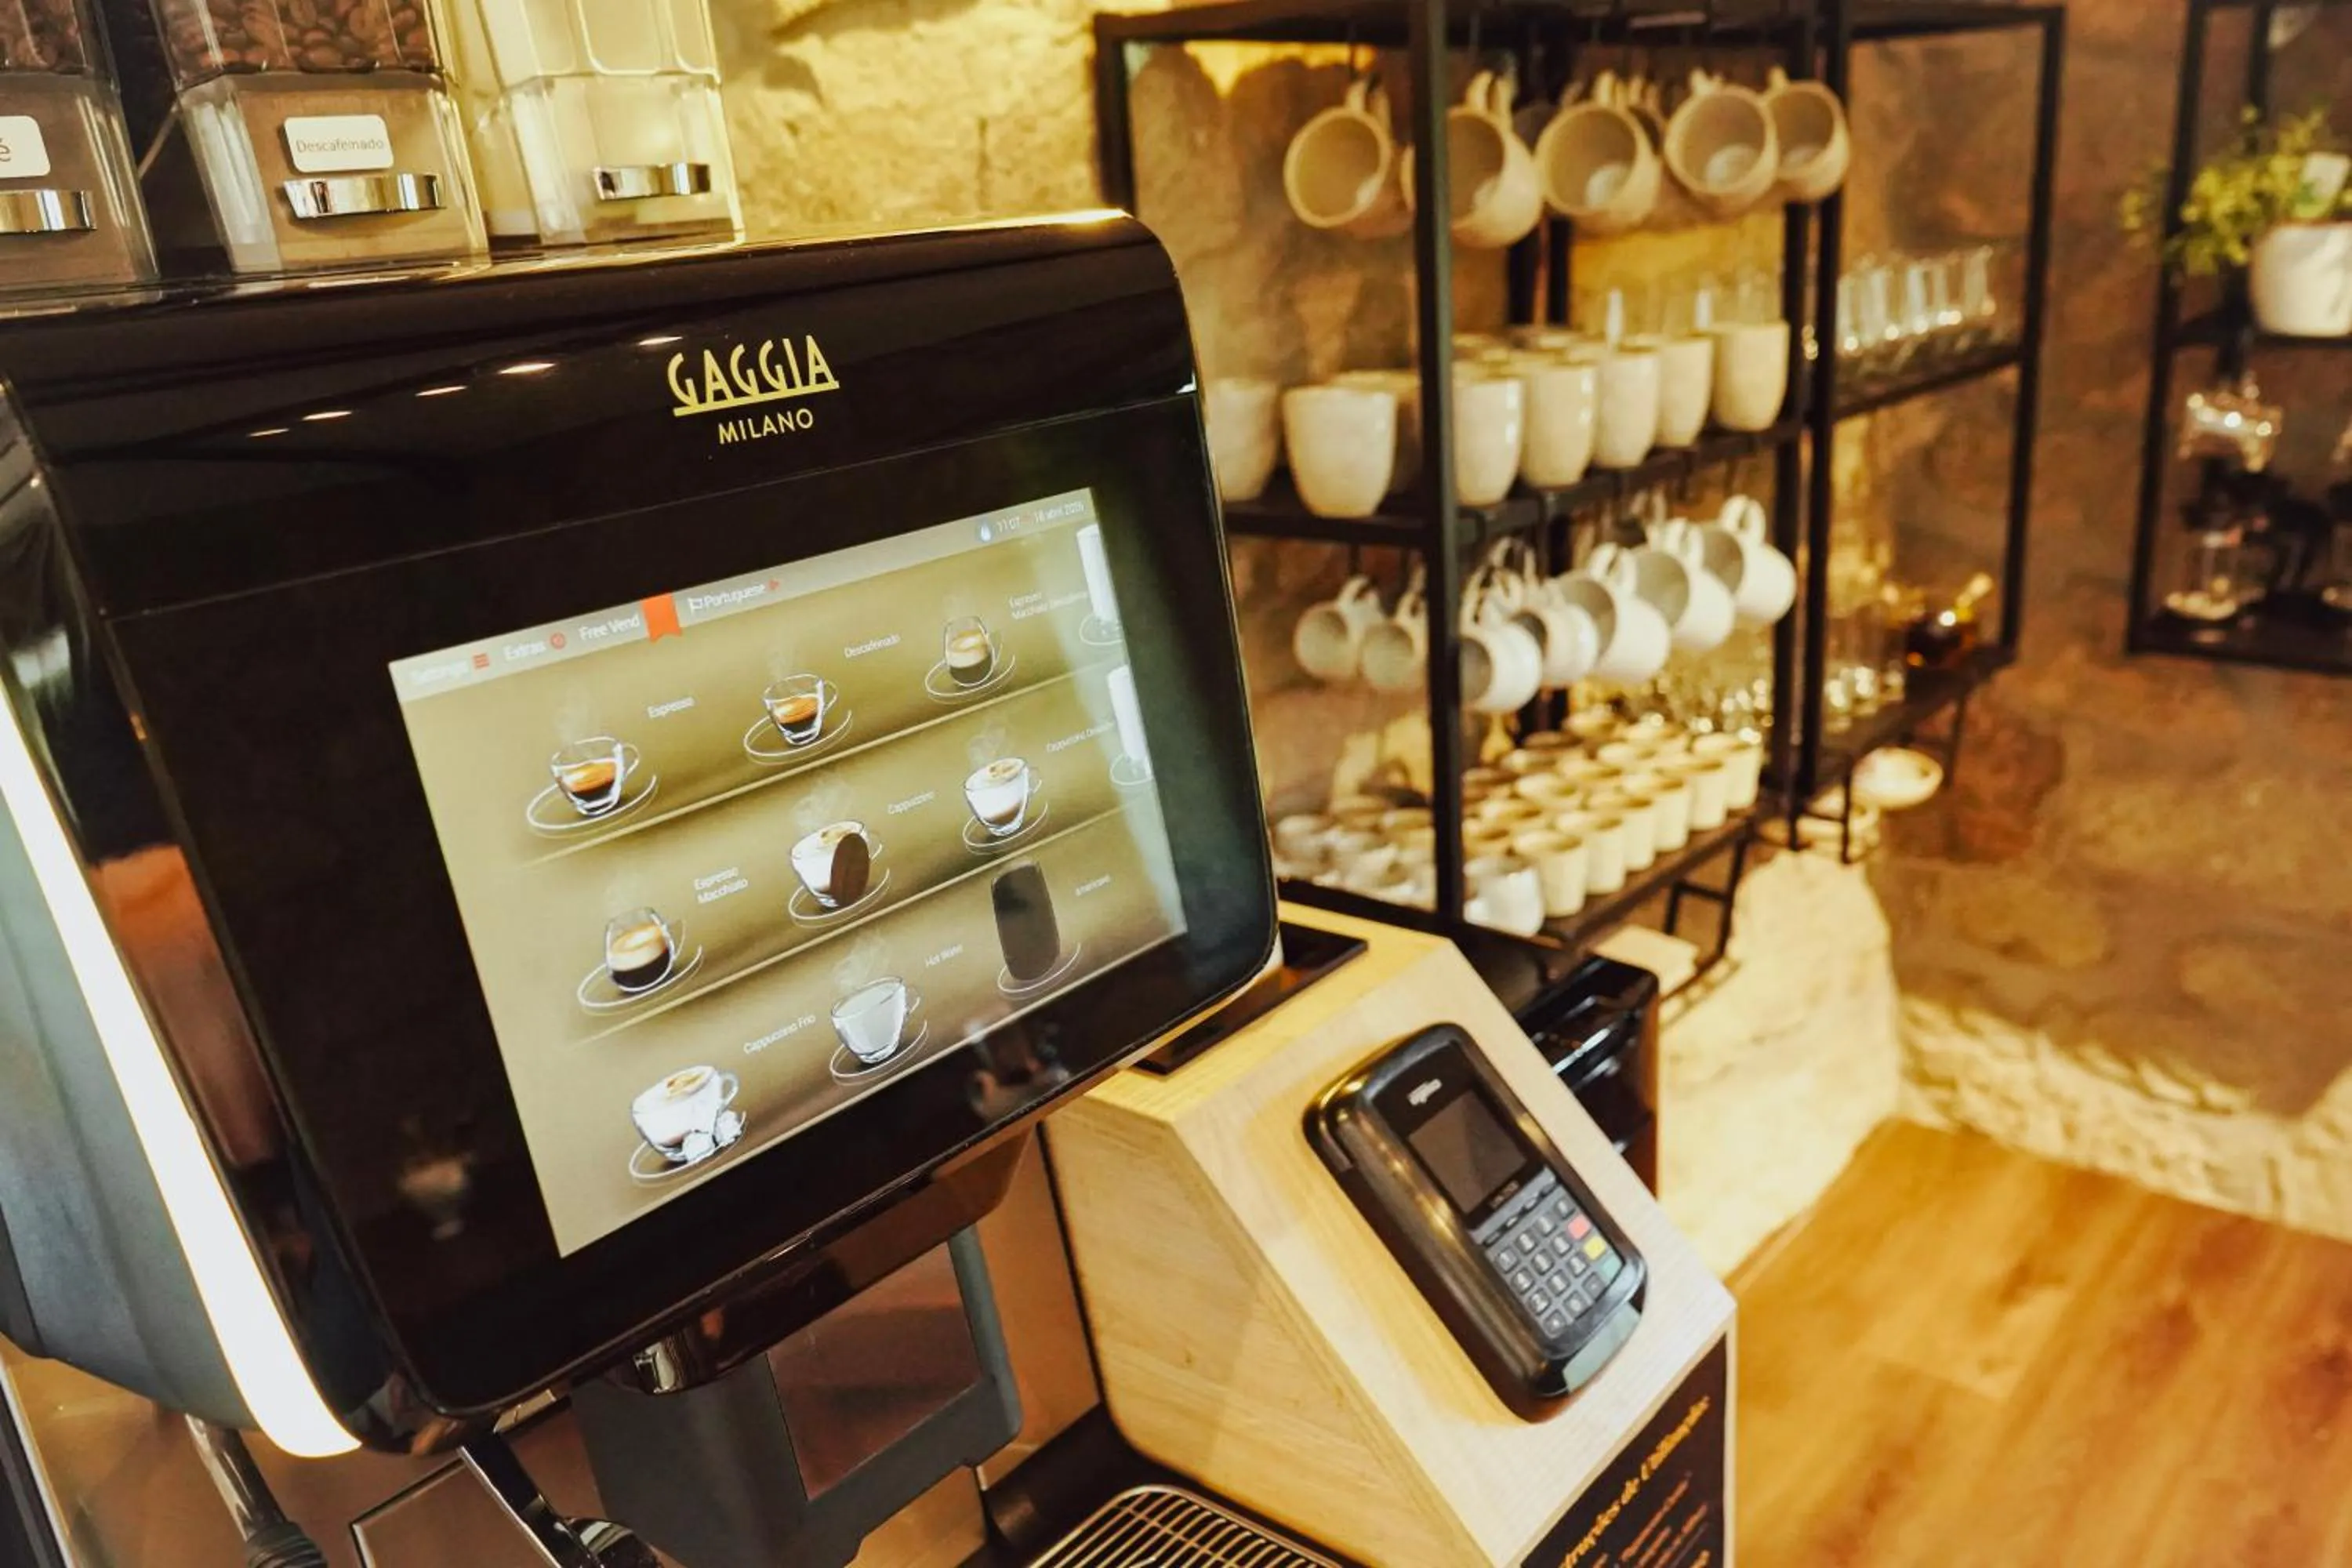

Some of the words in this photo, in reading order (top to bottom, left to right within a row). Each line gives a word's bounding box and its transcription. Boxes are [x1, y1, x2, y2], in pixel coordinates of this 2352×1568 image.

[296, 135, 385, 154] Descafeinado
[667, 334, 839, 412] GAGGIA
[718, 408, 814, 445] MILANO
[703, 584, 766, 609] Portuguese
[578, 622, 608, 641] Free
[608, 613, 641, 634] Vend
[503, 639, 547, 662] Extras
[844, 633, 901, 659] Descafeinado
[647, 695, 695, 719] Espresso
[694, 866, 739, 891] Espresso
[697, 878, 749, 904] Macchiato
[743, 1022, 798, 1054] Cappuccino
